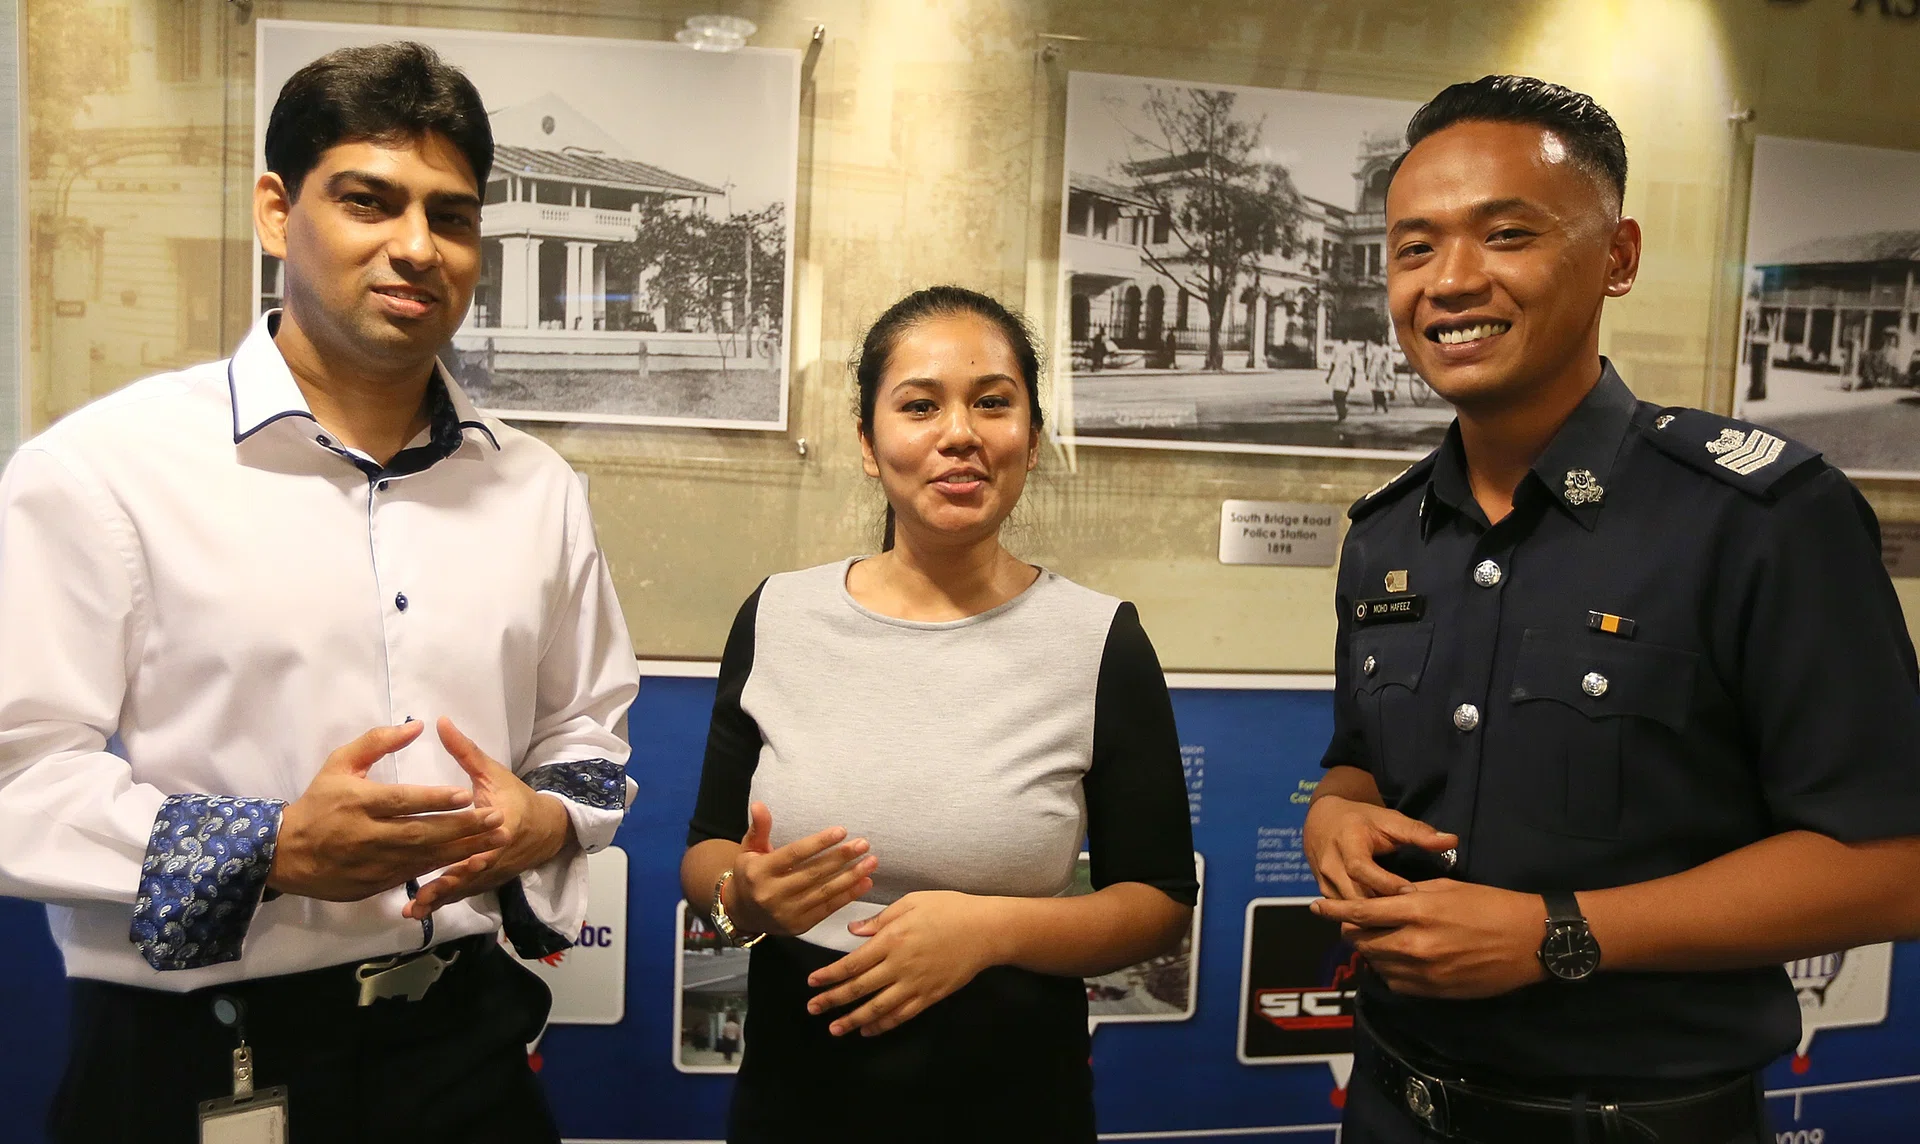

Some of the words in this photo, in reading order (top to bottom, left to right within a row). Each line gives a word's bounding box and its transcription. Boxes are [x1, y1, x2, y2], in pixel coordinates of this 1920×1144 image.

[1231, 512, 1261, 523] South
[1264, 514, 1299, 527] Bridge
[1303, 515, 1332, 526] Road
[1243, 528, 1277, 540] Police
[1280, 529, 1317, 540] Station
[1267, 543, 1292, 554] 1898
[1390, 601, 1411, 612] HAFEEZ
[1196, 768, 1204, 777] 4
[1257, 827, 1297, 838] Formerly
[1255, 851, 1302, 861] coverage
[1255, 862, 1300, 873] proactive
[1254, 873, 1265, 882] to
[1267, 873, 1299, 882] detect
